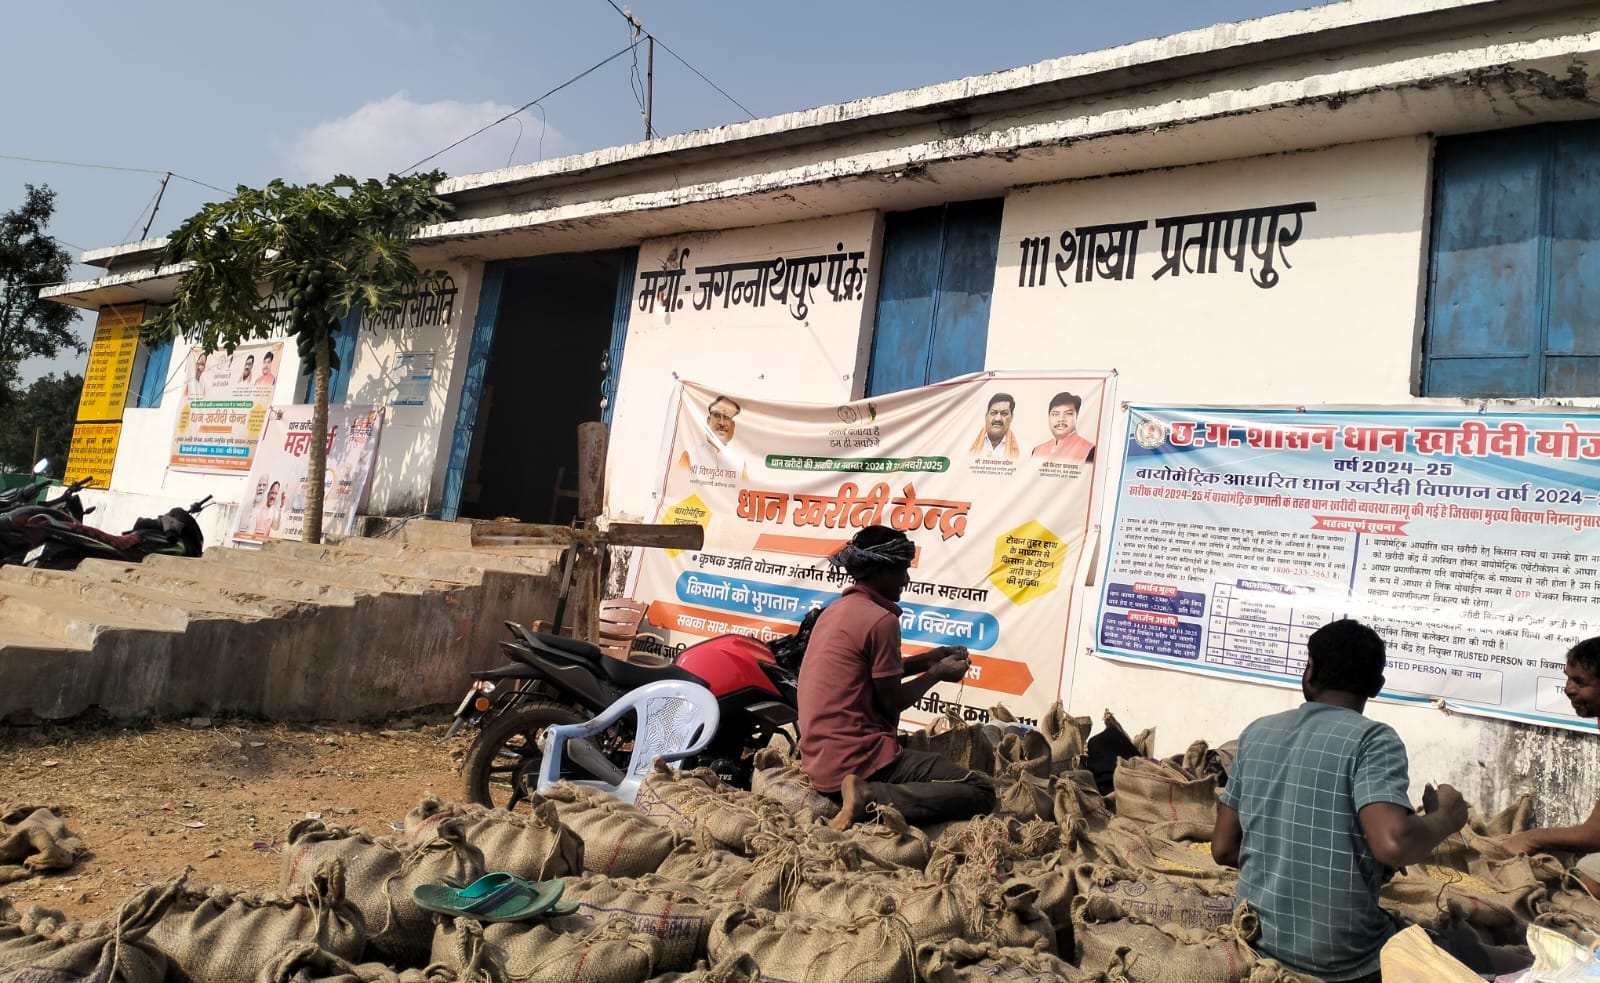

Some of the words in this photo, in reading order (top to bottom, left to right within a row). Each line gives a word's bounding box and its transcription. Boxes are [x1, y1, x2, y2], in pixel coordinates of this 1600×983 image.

[1019, 237, 1050, 287] 111
[1055, 220, 1148, 287] शाखा
[1151, 201, 1317, 289] प्रतापपुर
[693, 257, 827, 321] जगन्नाथपुर
[284, 424, 338, 457] महार्व
[1170, 422, 1240, 448] छ.ग.
[1247, 426, 1339, 451] शासन
[1344, 426, 1408, 454] धान
[1414, 420, 1530, 458] खरीदी
[1535, 423, 1600, 459] योज
[923, 461, 943, 470] 2025
[1334, 456, 1358, 473] वर्ष
[1362, 460, 1452, 476] 2024-25
[1135, 466, 1220, 487] बायोमेट्रिक
[1224, 472, 1298, 490] आधारित
[1302, 477, 1341, 492] धान
[1346, 476, 1410, 496] खरीदी
[1417, 478, 1491, 500] विपणन
[1496, 483, 1531, 502] वर्ष
[1535, 489, 1600, 505] 2024-
[737, 488, 789, 525] धान
[793, 481, 890, 529] खरीदी
[890, 481, 972, 542] केन्द्र
[1152, 484, 1165, 497] वर्ष
[1165, 488, 1202, 501] 2024-25
[1254, 493, 1281, 508] प्रणाली
[1313, 499, 1328, 511] धान
[1330, 497, 1357, 512] खरीदी
[1390, 504, 1411, 519] लागू
[1411, 503, 1424, 517] की
[1449, 504, 1483, 520] जिसका
[1510, 508, 1544, 524] विवरण
[1457, 544, 1478, 553] खरीदी
[1494, 546, 1517, 557] किसान
[700, 553, 725, 568] कृषक
[728, 556, 753, 572] उन्नति
[755, 558, 787, 577] योजना
[787, 562, 824, 582] अंतर्गत
[938, 584, 988, 602] सहायता
[1007, 576, 1016, 585] की
[686, 576, 730, 600] किसानों
[732, 584, 750, 604] को
[752, 590, 799, 613] भुगतान
[918, 609, 974, 639] क्विंटल
[1514, 590, 1531, 598] OTP
[1562, 592, 1587, 603] किसान
[677, 614, 706, 630] सबका
[1412, 664, 1447, 676] PERSON
[1454, 650, 1488, 662] TRUSTED
[1491, 654, 1523, 666] PERSON
